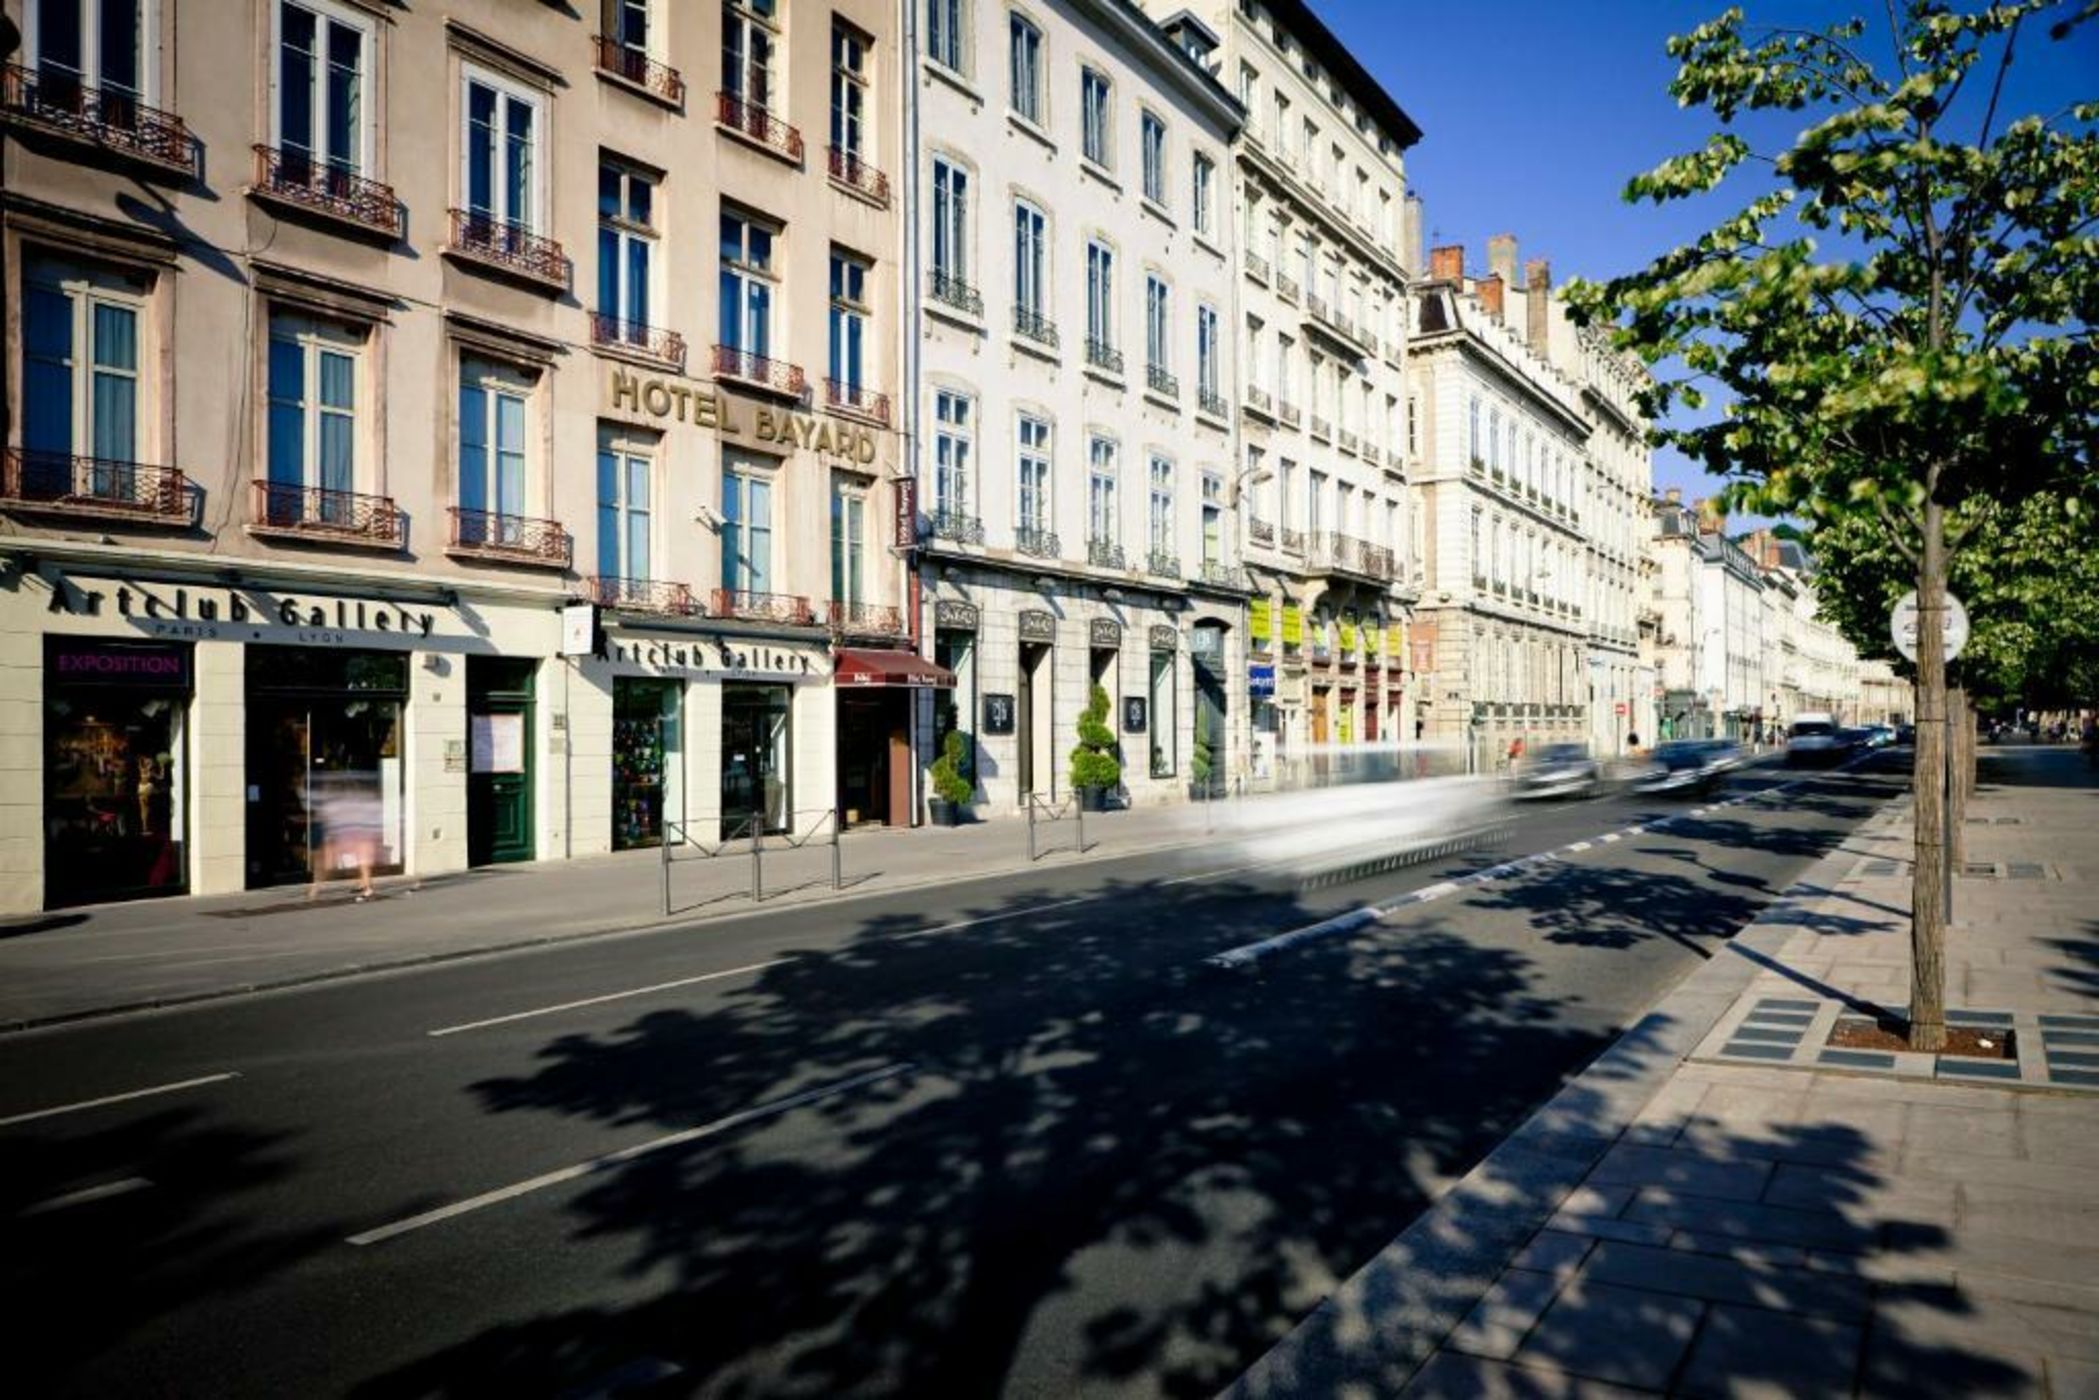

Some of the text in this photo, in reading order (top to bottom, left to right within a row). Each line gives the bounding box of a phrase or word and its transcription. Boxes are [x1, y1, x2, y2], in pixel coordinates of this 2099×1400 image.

[611, 372, 876, 464] HOTEL BAYARD
[49, 580, 433, 638] Artclub Gallery
[156, 624, 344, 643] PARIS LYON
[58, 655, 180, 674] EXPOSITION
[597, 641, 809, 676] Artclub Gallery
